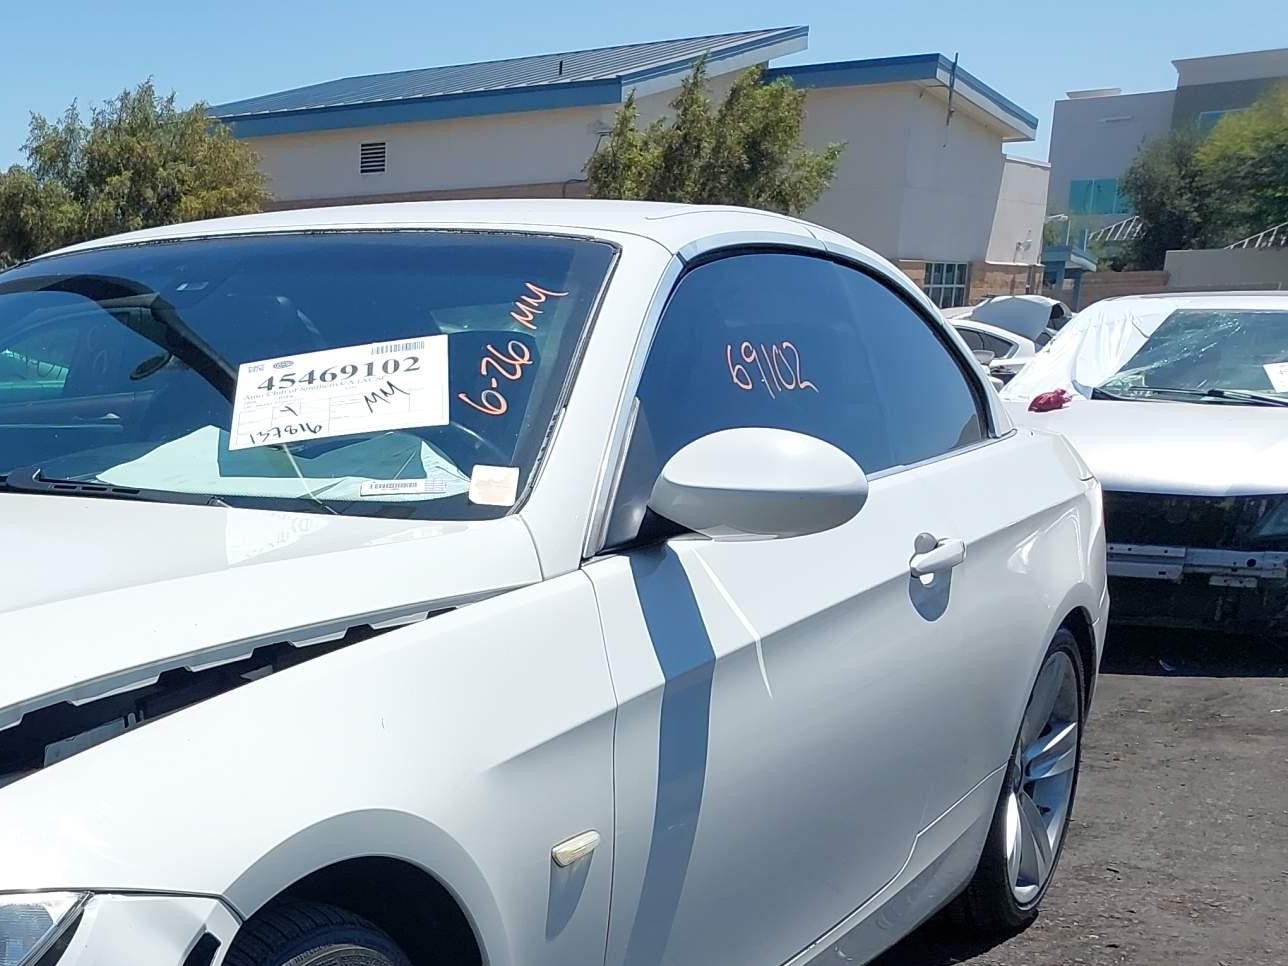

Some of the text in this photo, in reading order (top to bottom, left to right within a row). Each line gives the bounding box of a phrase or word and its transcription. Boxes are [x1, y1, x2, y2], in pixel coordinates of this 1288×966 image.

[257, 356, 421, 391] 45469102
[458, 340, 533, 415] 6-26
[726, 341, 820, 400] 69102
